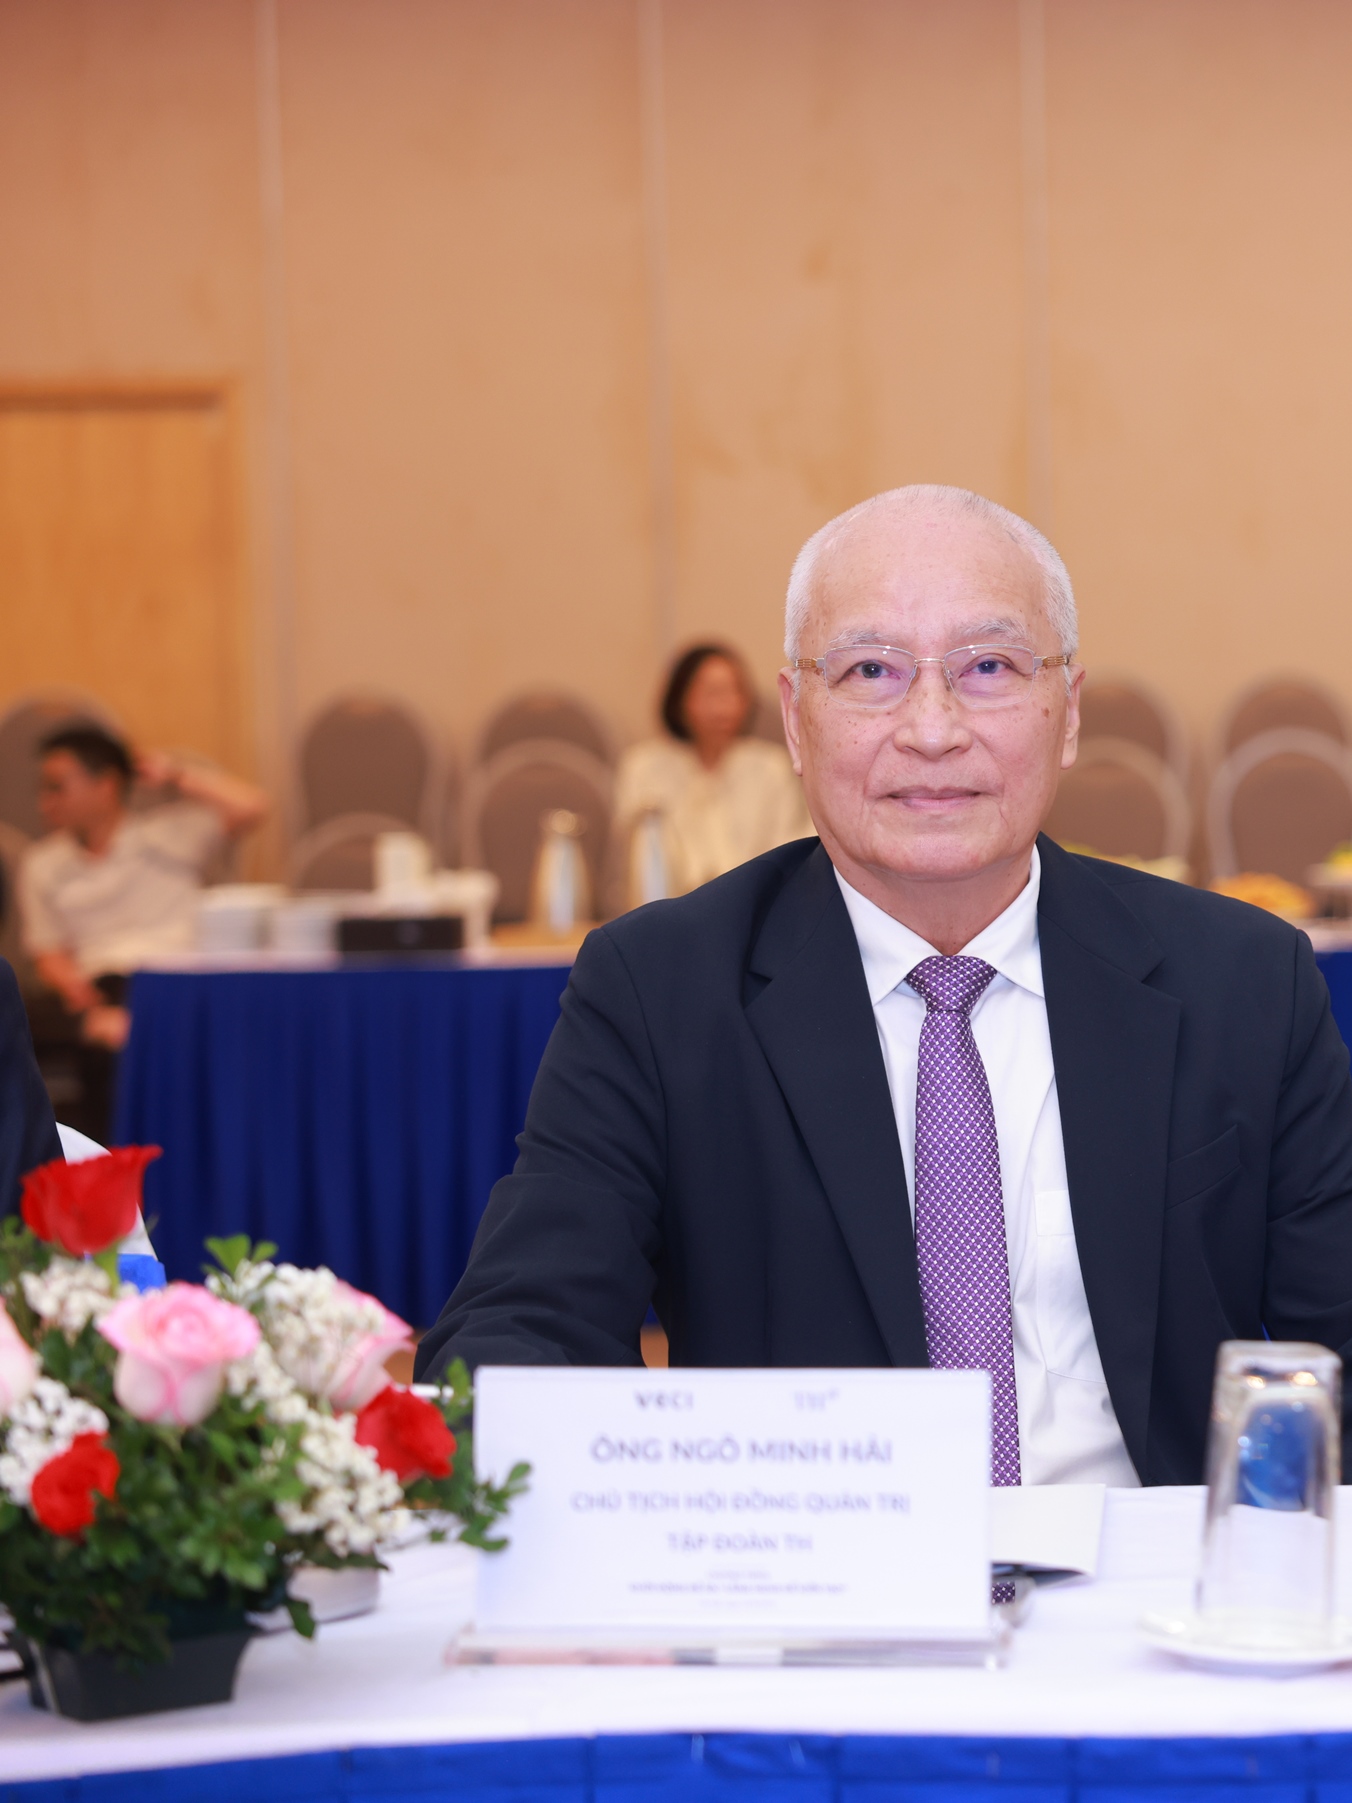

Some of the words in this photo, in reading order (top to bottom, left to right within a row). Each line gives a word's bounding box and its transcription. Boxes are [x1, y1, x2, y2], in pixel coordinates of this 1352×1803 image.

[590, 1432, 663, 1464] ÔNG
[670, 1432, 742, 1464] NGÔ
[748, 1437, 832, 1464] MINH
[570, 1487, 623, 1514] CHỦ
[628, 1491, 681, 1517] TỊCH
[685, 1487, 729, 1517] HỘI
[731, 1486, 802, 1514] ĐỒNG
[877, 1491, 912, 1517] TRỊ
[667, 1529, 711, 1554] TẬP
[712, 1529, 780, 1553] ĐOÀN
[783, 1533, 815, 1553] TH
